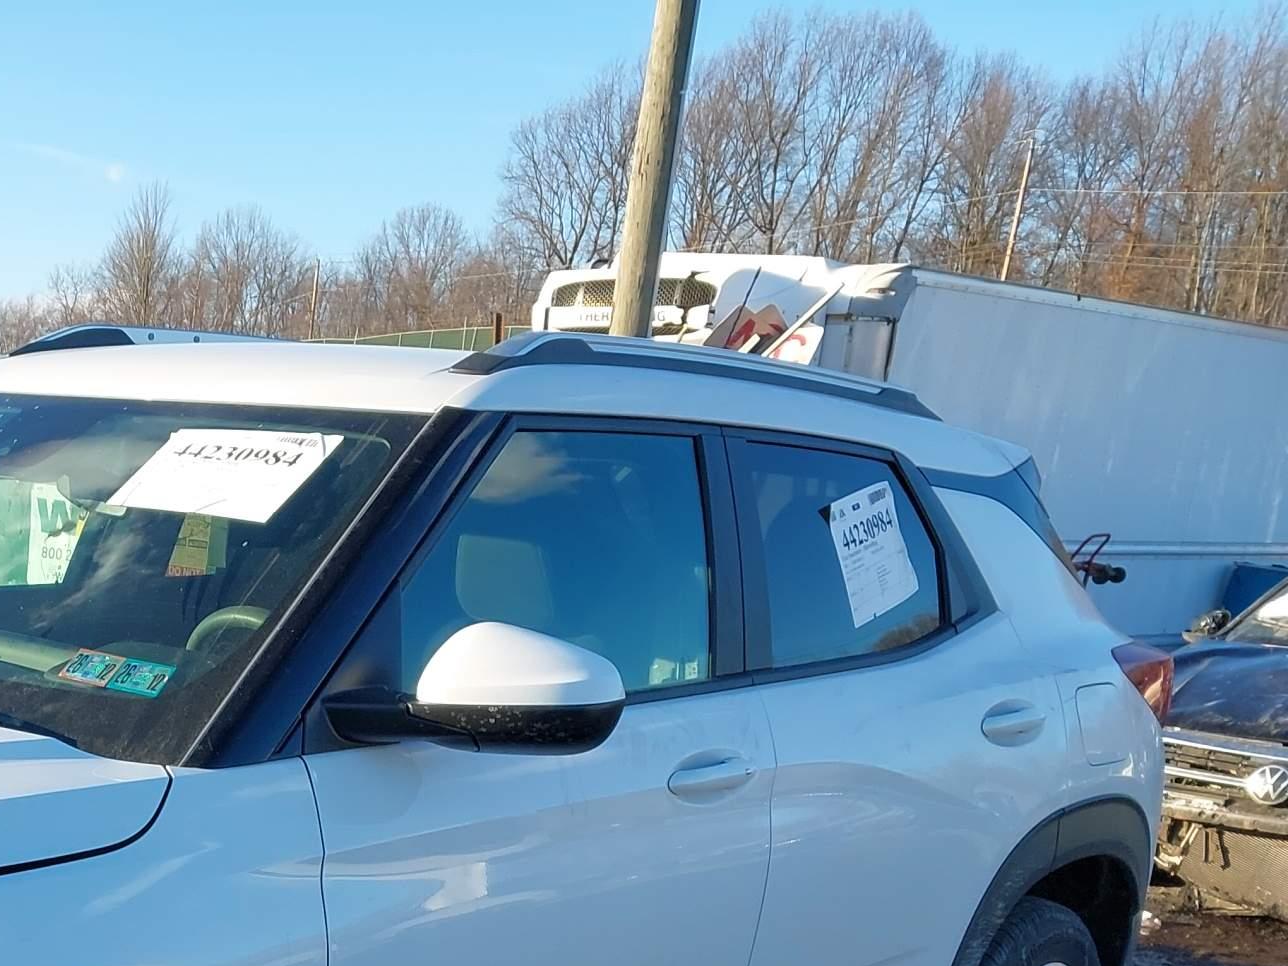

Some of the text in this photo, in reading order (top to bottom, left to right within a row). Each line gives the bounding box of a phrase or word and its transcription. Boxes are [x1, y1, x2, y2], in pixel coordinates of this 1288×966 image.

[173, 442, 305, 468] 44230984
[842, 507, 894, 551] 44230984
[41, 546, 63, 561] 800
